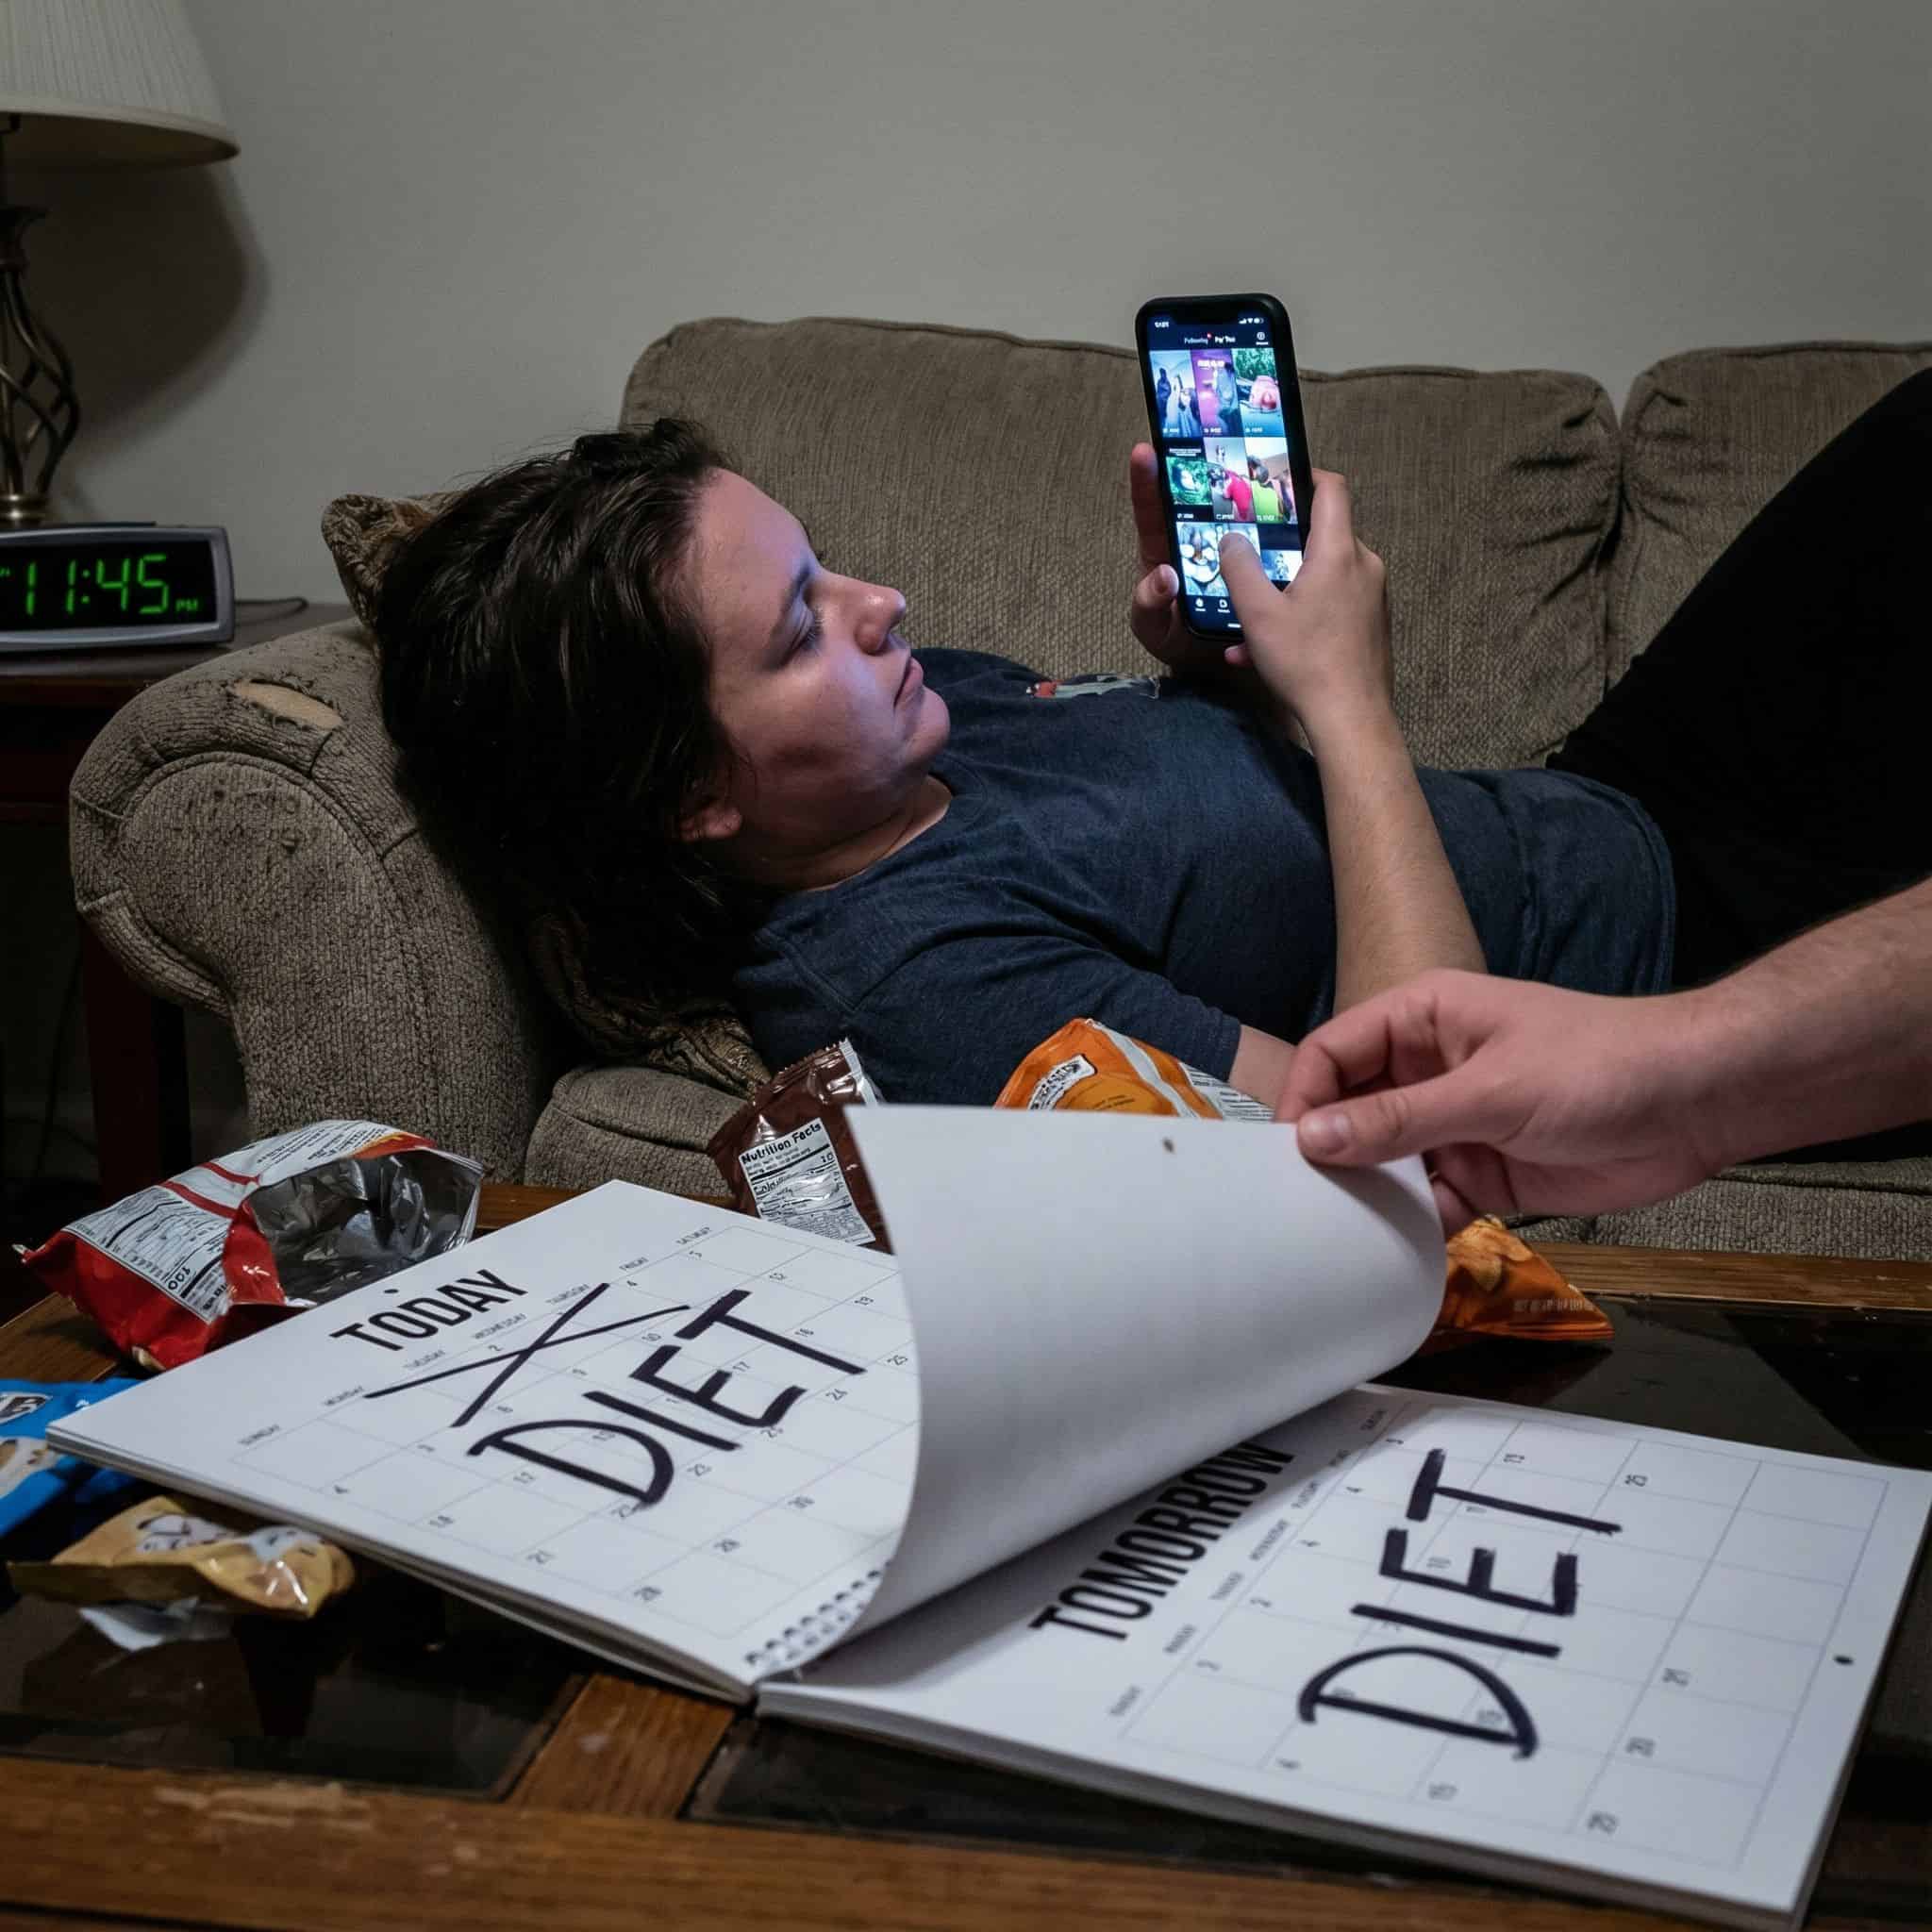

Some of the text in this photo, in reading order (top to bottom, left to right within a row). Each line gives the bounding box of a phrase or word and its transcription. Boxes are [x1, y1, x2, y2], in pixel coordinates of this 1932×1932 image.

[25, 553, 168, 615] 11:45
[741, 1139, 791, 1164] Nutrition
[792, 1123, 822, 1143] Facts
[328, 1269, 529, 1351] TODAY
[466, 1288, 868, 1507] DIET
[1028, 1441, 1295, 1641] TOMORROW
[1298, 1448, 1623, 1760] DIET
